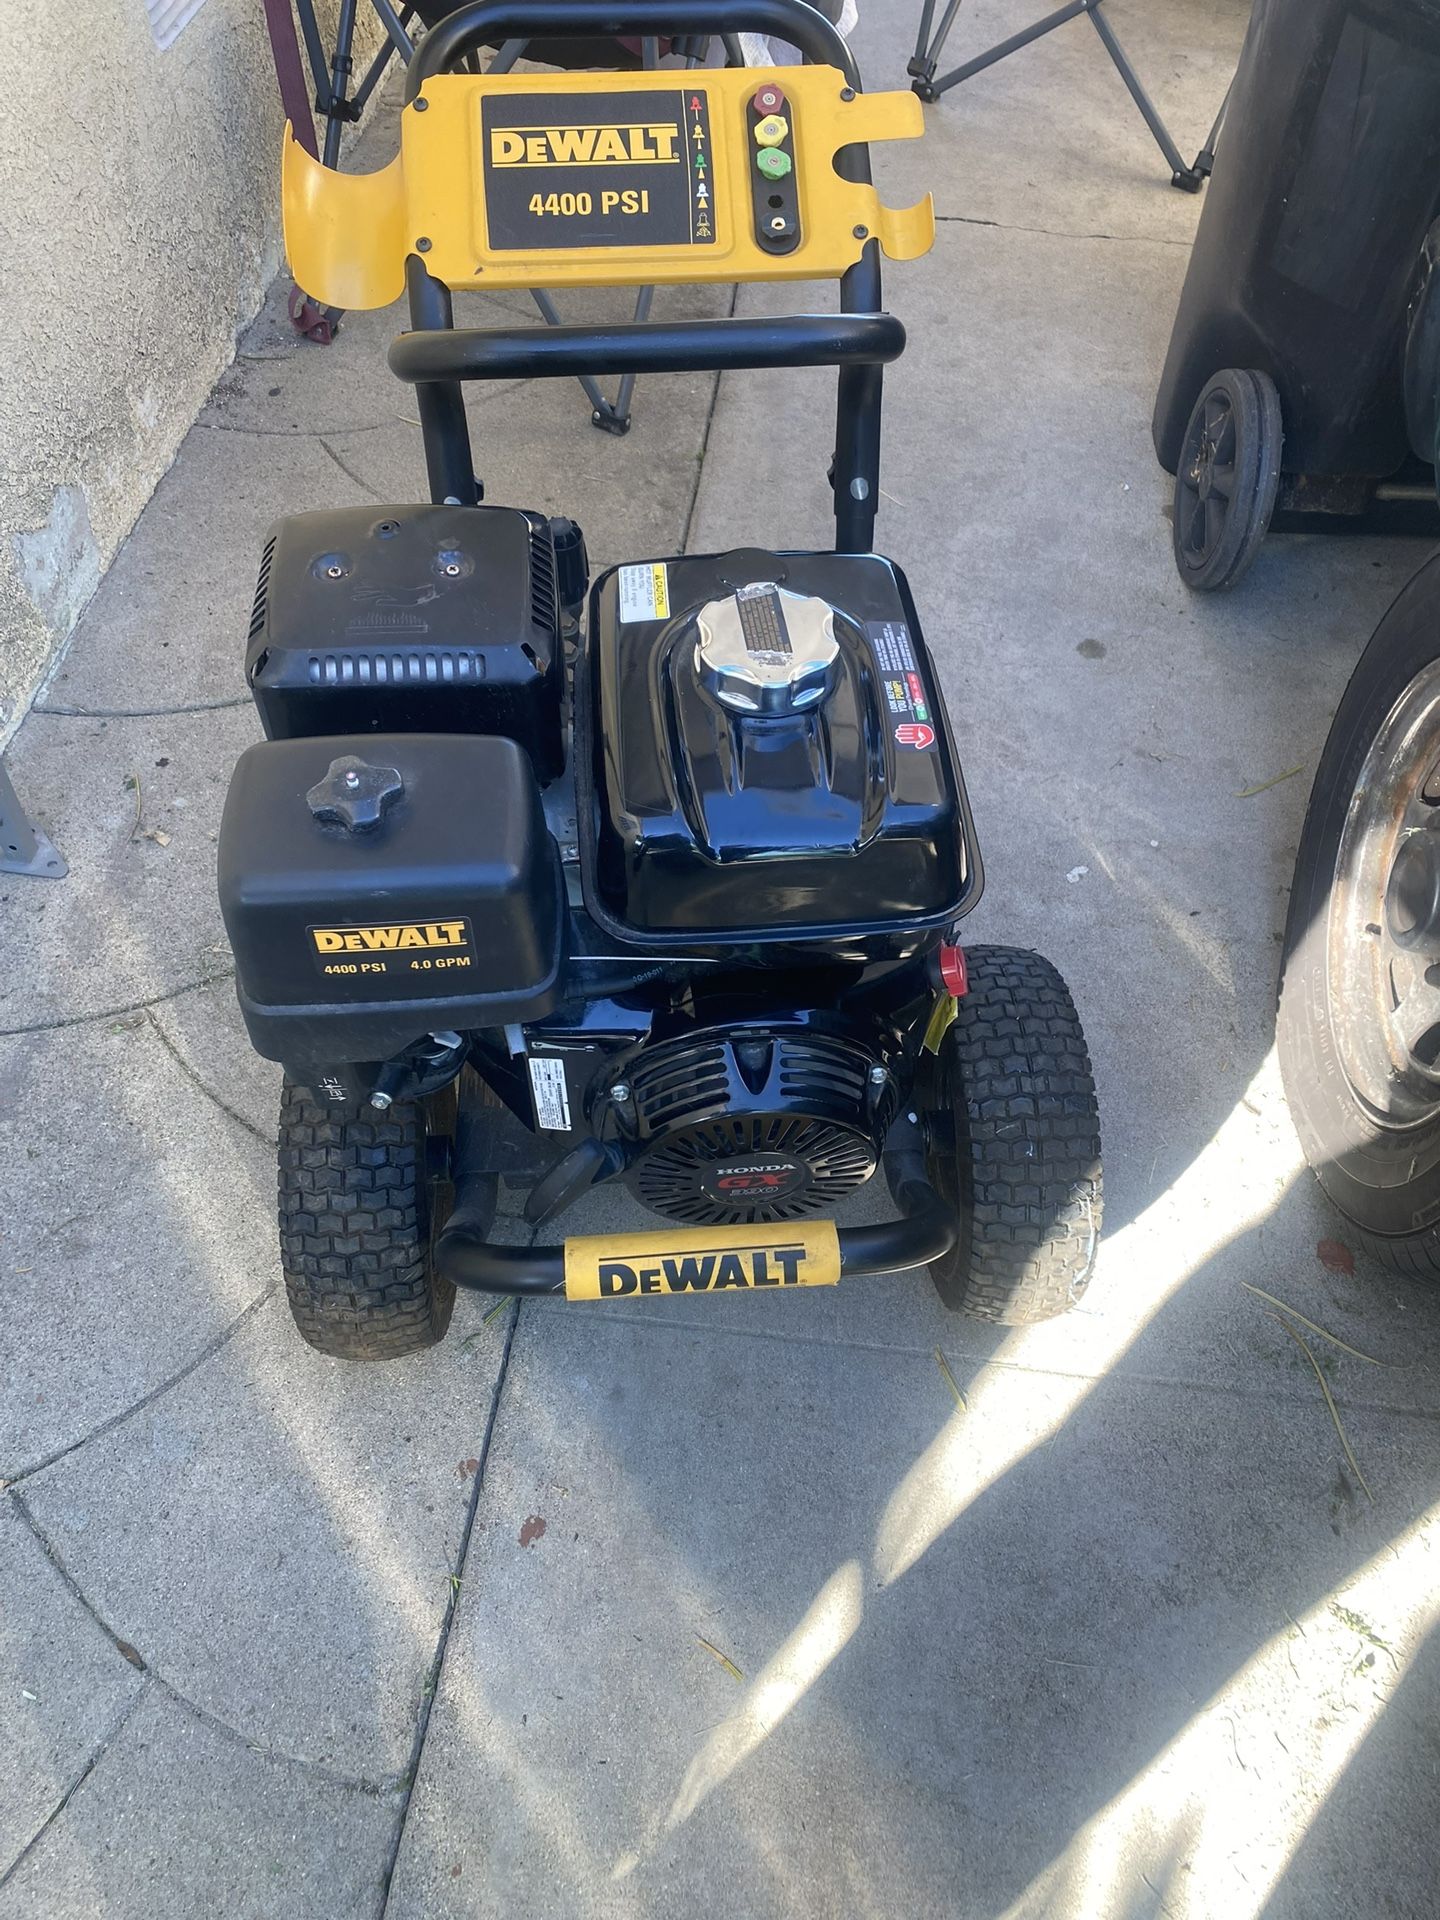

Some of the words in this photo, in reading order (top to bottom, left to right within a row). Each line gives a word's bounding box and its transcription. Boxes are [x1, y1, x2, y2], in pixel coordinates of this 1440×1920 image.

[528, 192, 592, 216] 4400
[601, 190, 649, 214] PSI
[655, 581, 665, 605] CAUTION
[324, 964, 358, 975] 4400
[361, 962, 387, 973] PSI
[410, 959, 432, 970] 4.0
[435, 956, 471, 969] GPM
[716, 1164, 797, 1175] HONDA
[718, 1171, 789, 1189] GX
